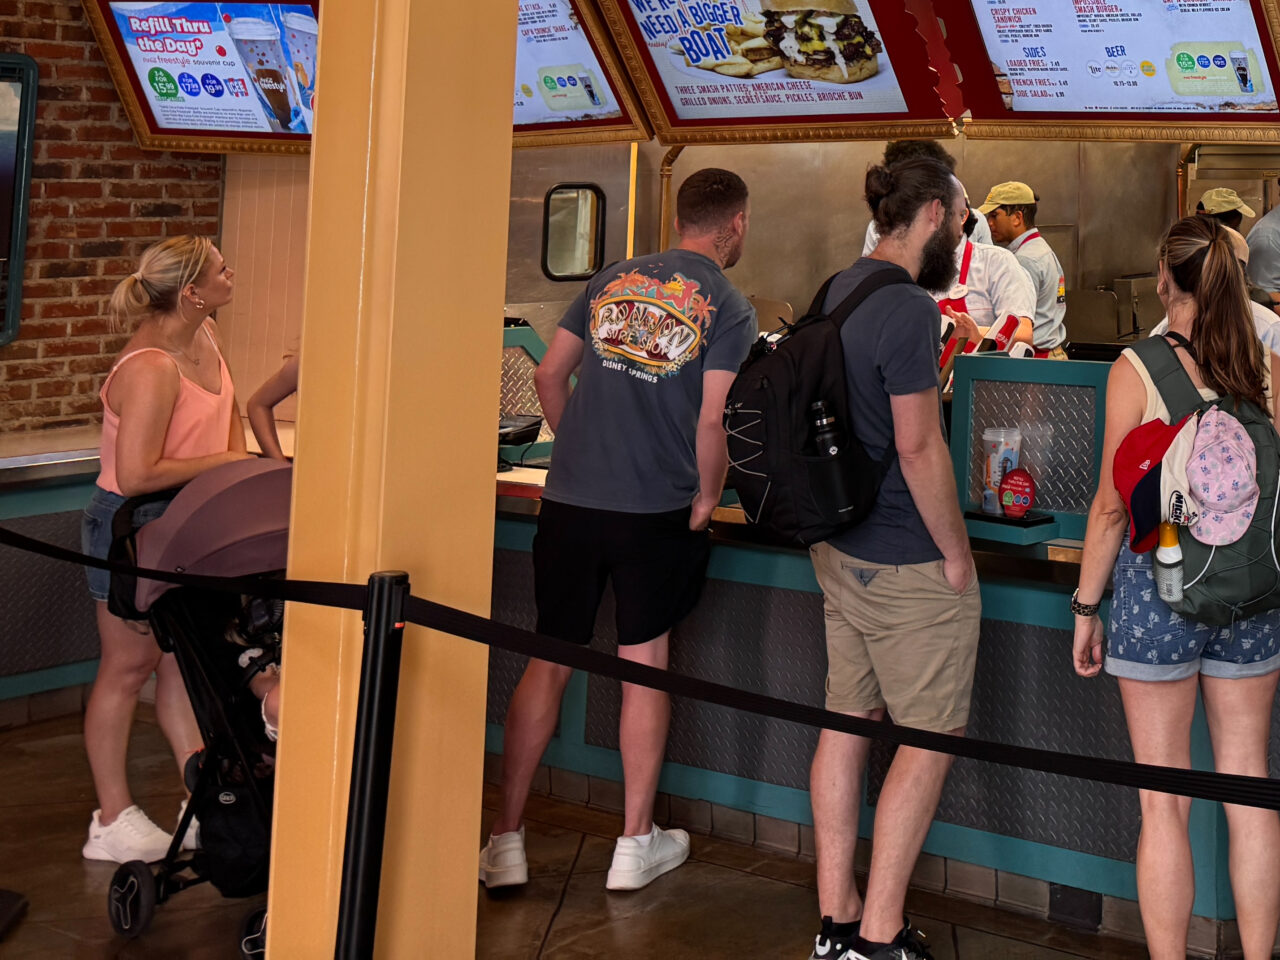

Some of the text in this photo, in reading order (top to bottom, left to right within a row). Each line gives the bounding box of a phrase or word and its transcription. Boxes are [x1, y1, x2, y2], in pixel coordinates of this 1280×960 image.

[990, 8, 1010, 16] CRISPY
[1096, 5, 1119, 13] BURGER
[130, 17, 211, 34] Refill Thru
[640, 1, 744, 40] NEED A BIGGER
[993, 16, 1022, 24] SANDWICH
[137, 38, 163, 52] the
[678, 27, 732, 65] BOAT
[1105, 45, 1126, 57] BEER
[1022, 46, 1047, 58] SIDES
[157, 56, 191, 67] freestyle
[1006, 59, 1045, 67] LOADED FRIES
[675, 86, 695, 95] THREE
[697, 85, 719, 94] SMASH
[751, 82, 785, 92] AMERICAN
[786, 81, 816, 90] CHEESE,
[1035, 78, 1051, 86] FRIES
[680, 97, 706, 106] GRILLED
[760, 95, 785, 104] SAUCE,
[785, 93, 817, 103] PICKLES,
[817, 92, 848, 102] BRIOCHE
[849, 91, 864, 100] BUN
[606, 328, 670, 355] SURF SHOP
[602, 360, 658, 384] DISNEY SPRINGS
